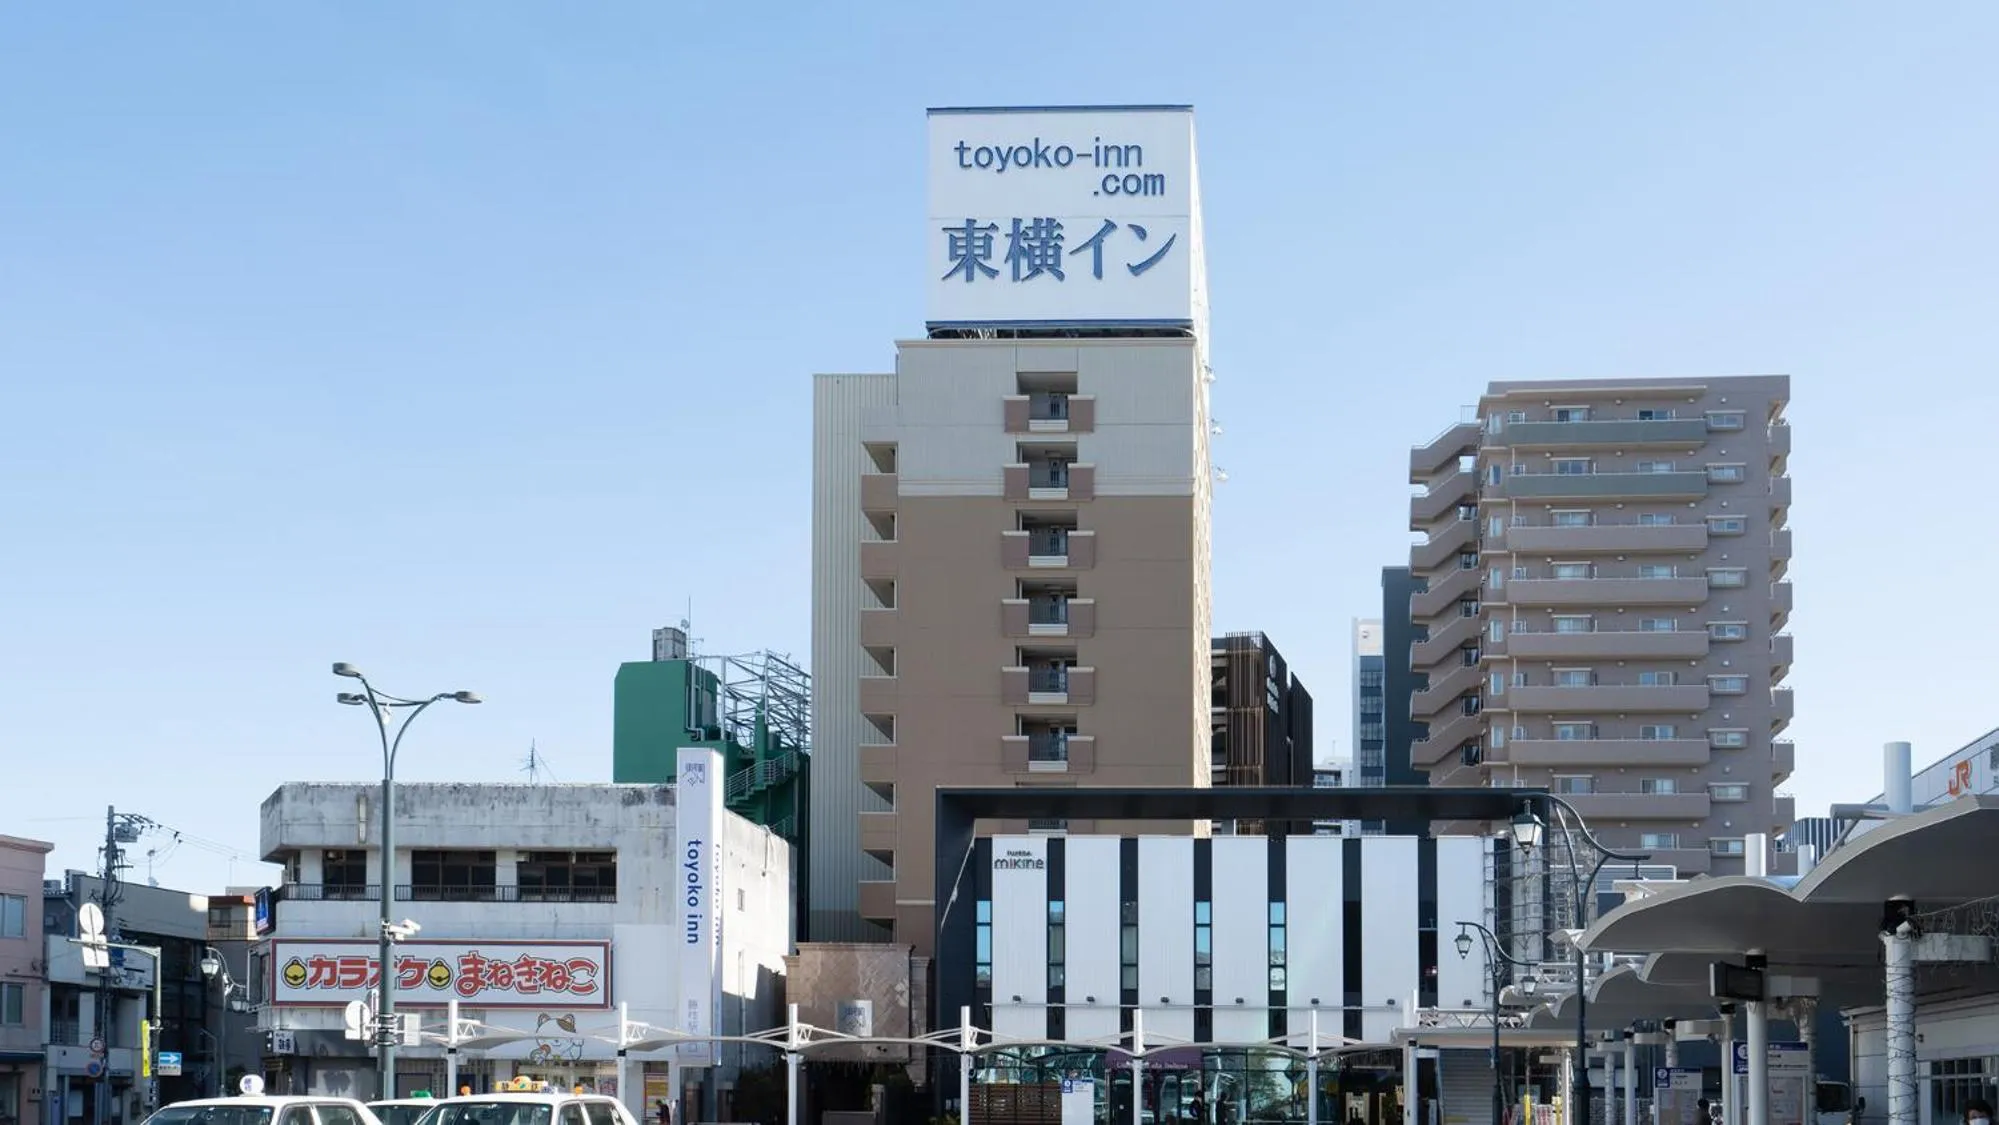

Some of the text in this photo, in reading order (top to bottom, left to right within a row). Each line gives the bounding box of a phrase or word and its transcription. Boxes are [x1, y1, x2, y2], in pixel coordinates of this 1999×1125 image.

[954, 137, 1143, 173] toyoko-inn
[1093, 173, 1165, 196] .com
[941, 217, 1177, 282] 東横イン
[1948, 759, 1972, 797] JR
[994, 858, 1045, 869] mikine
[684, 839, 703, 944] toyoko inn
[454, 951, 599, 996] まねきねこ
